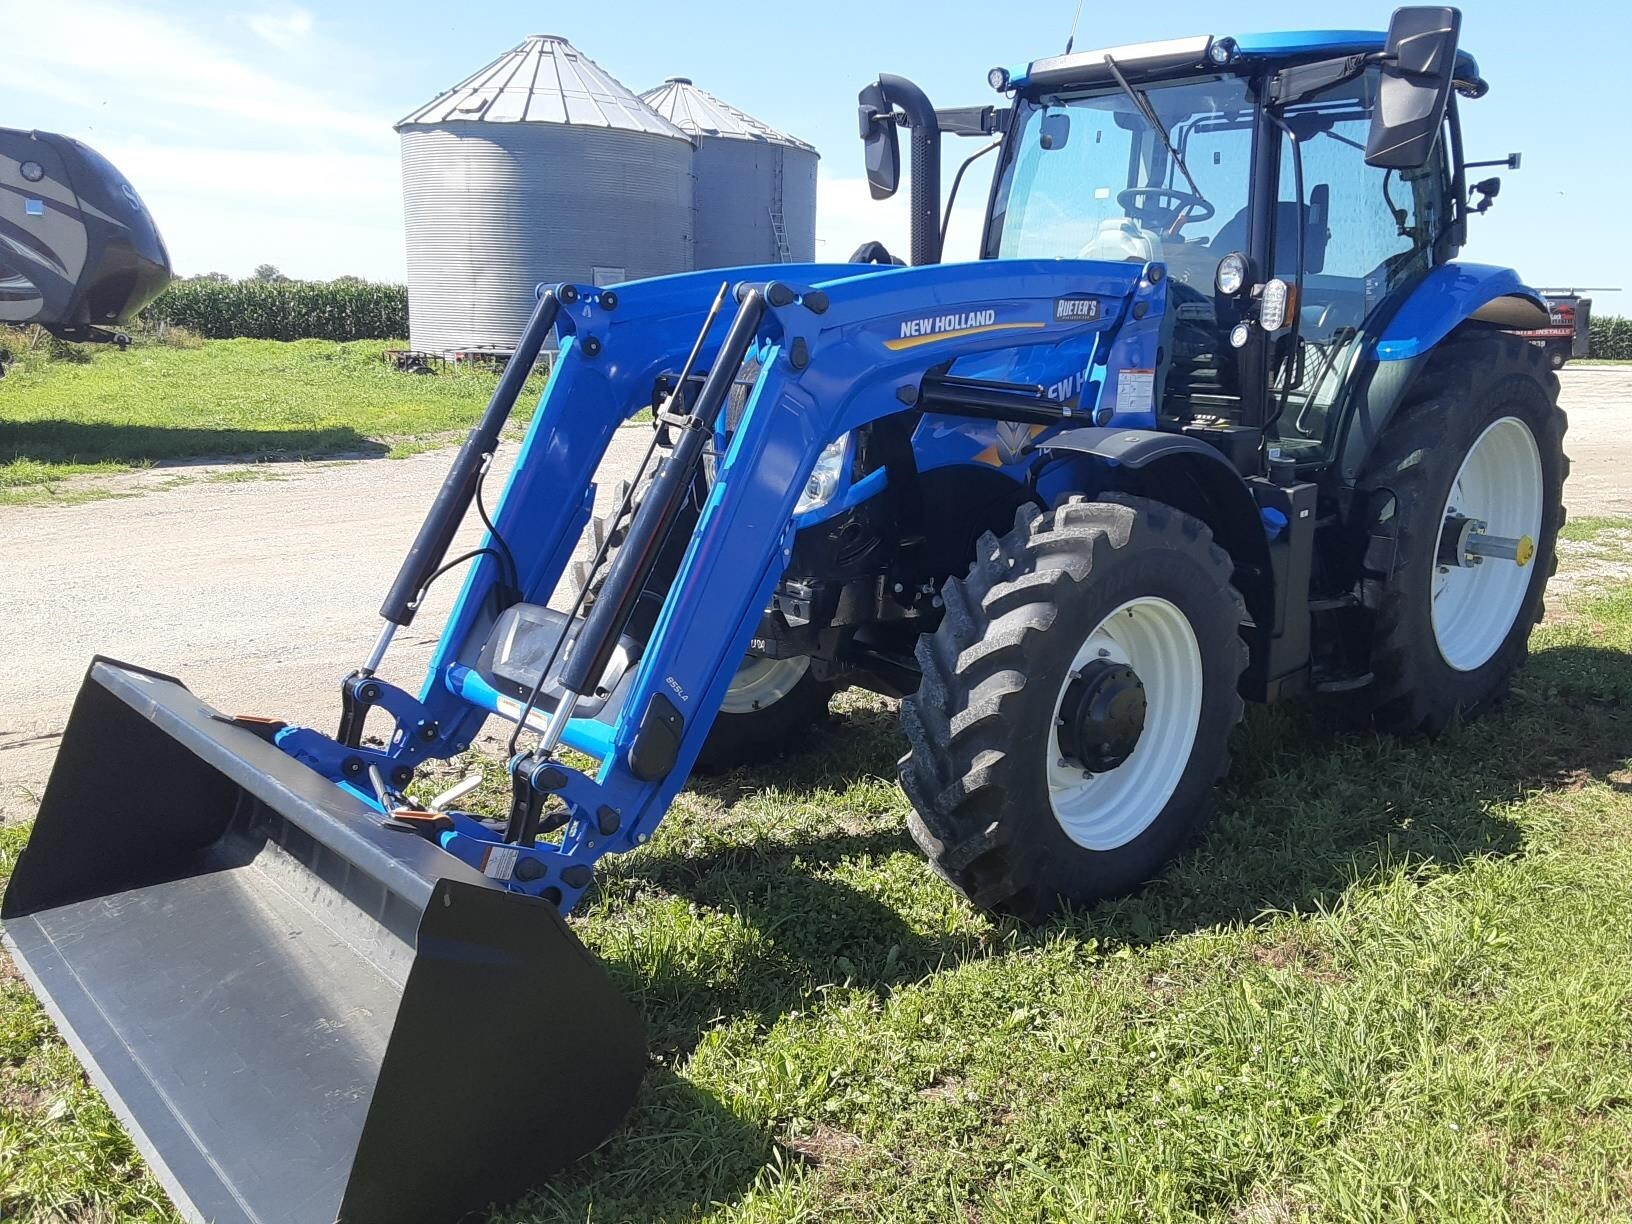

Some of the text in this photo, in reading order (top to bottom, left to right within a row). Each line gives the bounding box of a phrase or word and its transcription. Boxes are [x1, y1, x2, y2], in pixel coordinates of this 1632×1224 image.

[1056, 299, 1097, 318] RUETER'S
[900, 309, 995, 338] NEW HOLLAND
[1047, 375, 1074, 402] EW
[1075, 369, 1087, 393] H
[665, 676, 689, 702] 855LA
